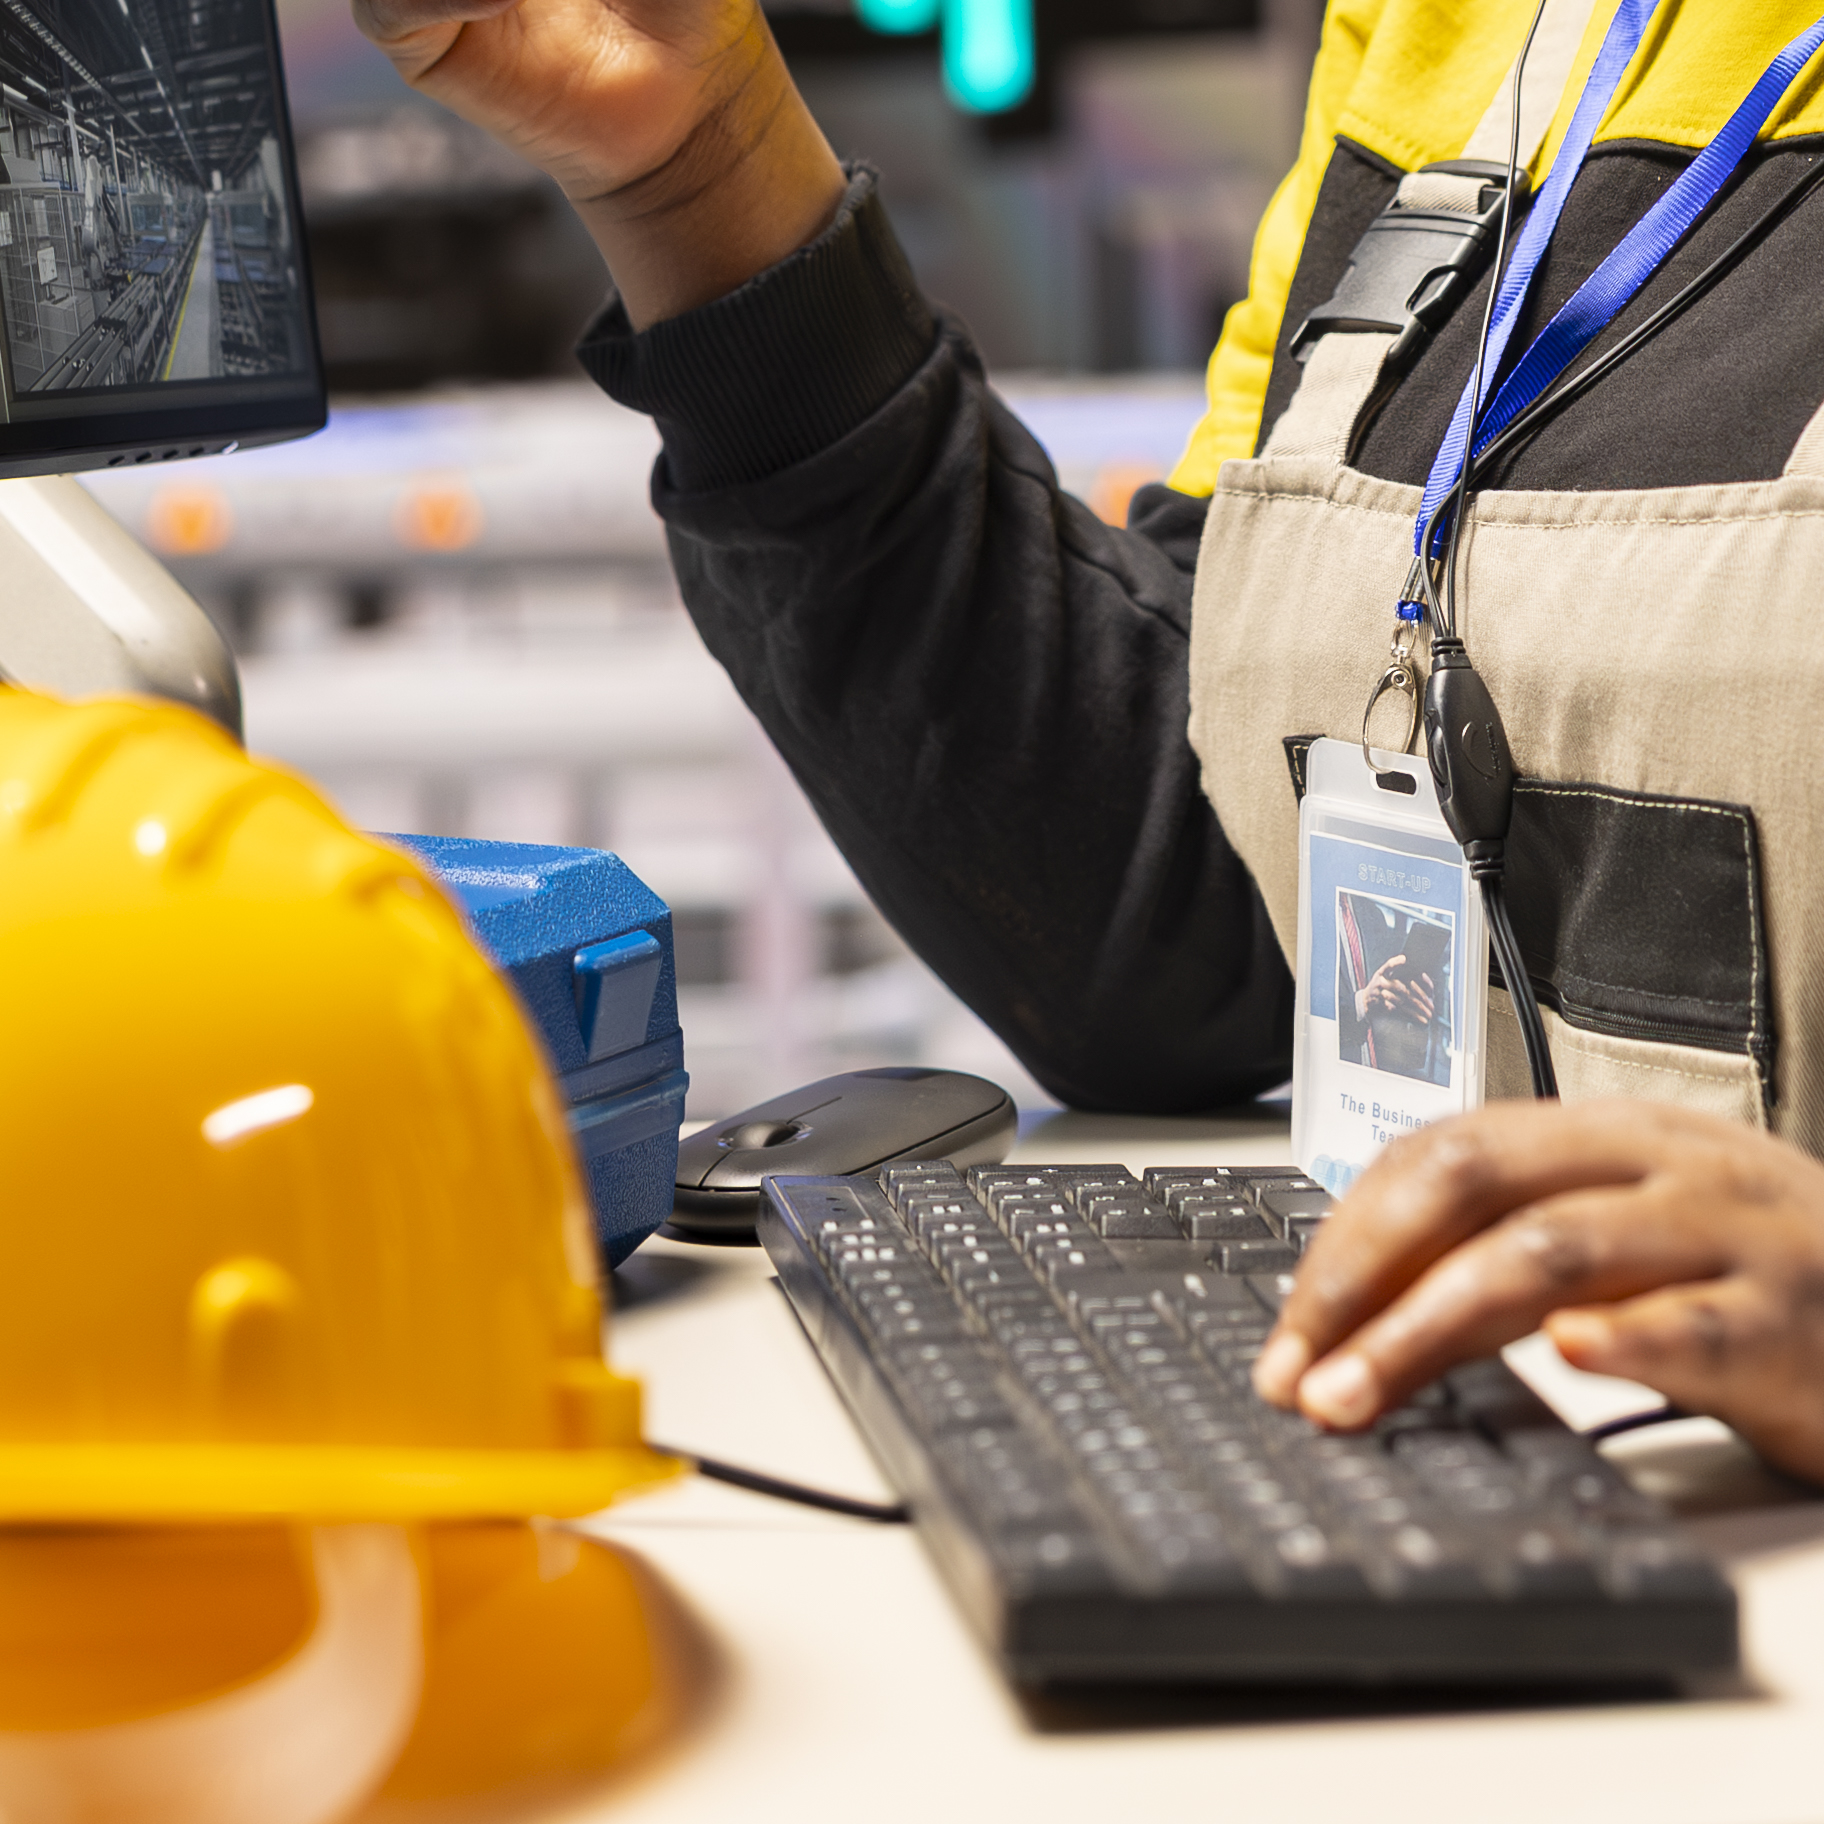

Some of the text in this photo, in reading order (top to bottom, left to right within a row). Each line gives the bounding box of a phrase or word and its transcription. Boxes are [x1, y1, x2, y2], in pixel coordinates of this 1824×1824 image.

[1358, 862, 1431, 894] START-UP
[1340, 1093, 1366, 1114] The
[1371, 1124, 1403, 1145] Tea
